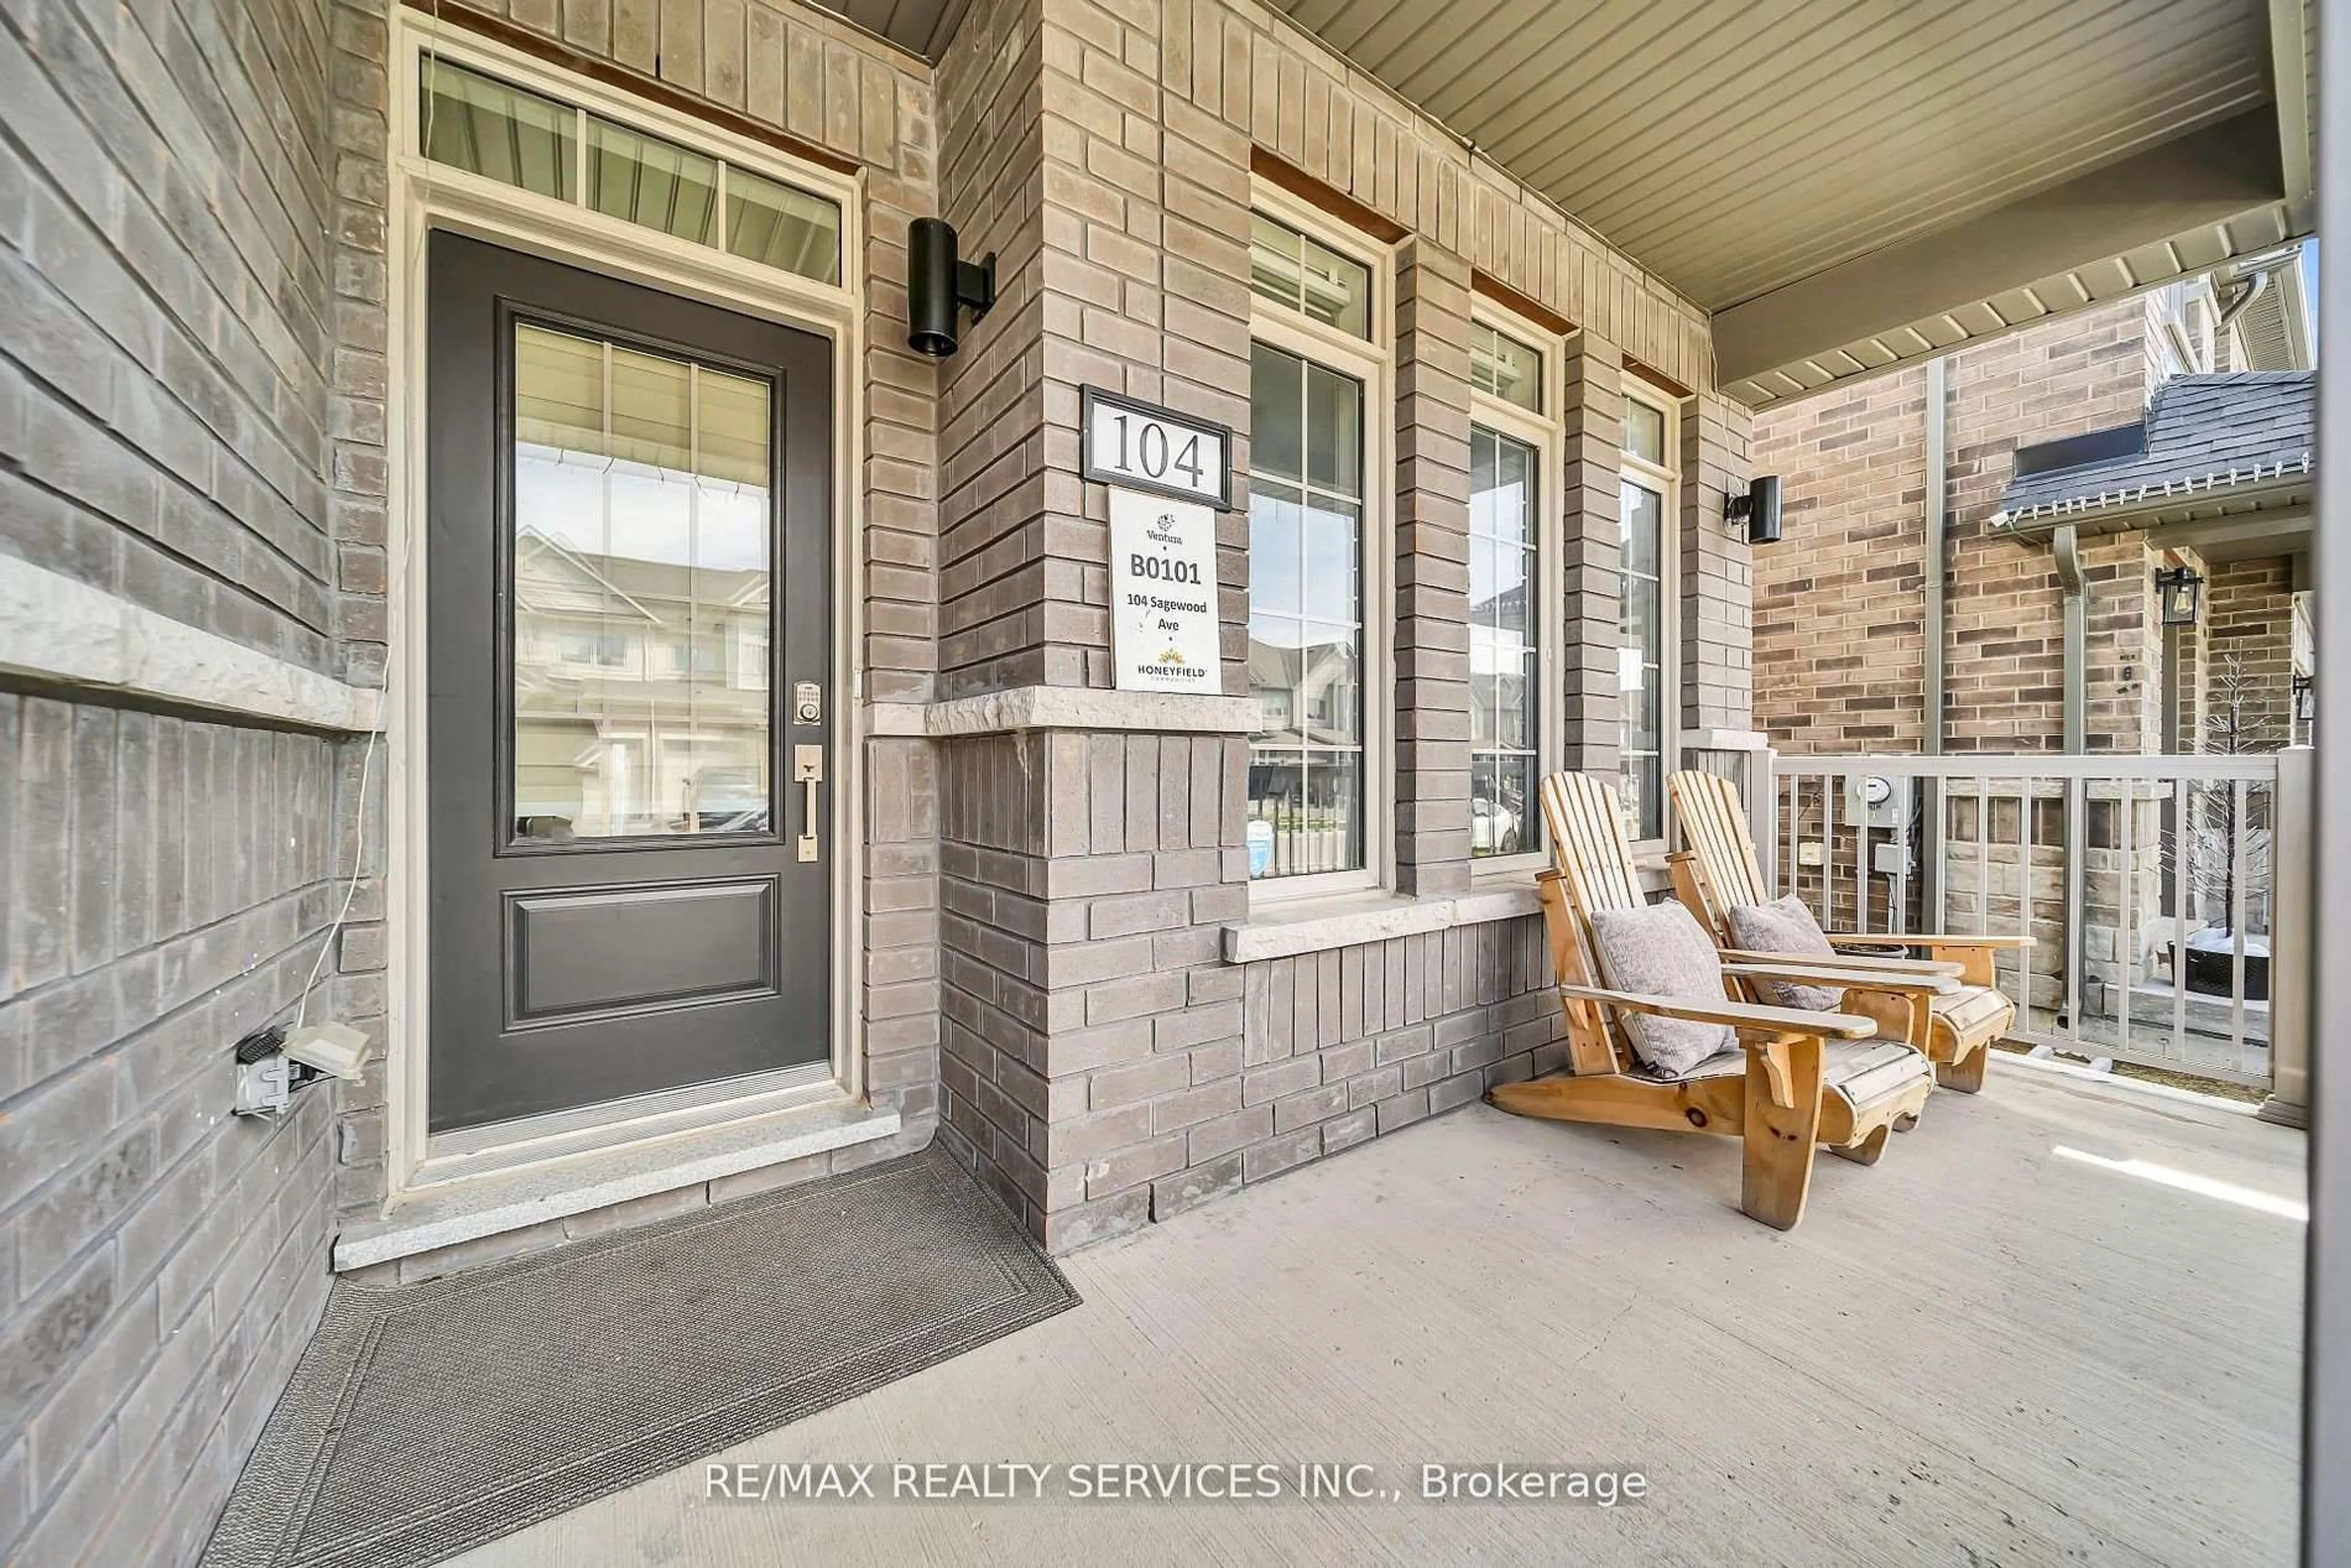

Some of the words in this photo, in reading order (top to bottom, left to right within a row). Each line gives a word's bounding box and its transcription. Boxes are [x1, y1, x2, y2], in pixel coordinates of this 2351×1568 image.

[1114, 415, 1204, 487] 104
[1147, 530, 1182, 545] Ventura
[1131, 553, 1201, 585] B0101
[1127, 594, 1148, 606] 104
[1150, 596, 1207, 613] Sagewood
[1158, 618, 1179, 631] Ave
[1138, 665, 1205, 678] HONEYFIELD
